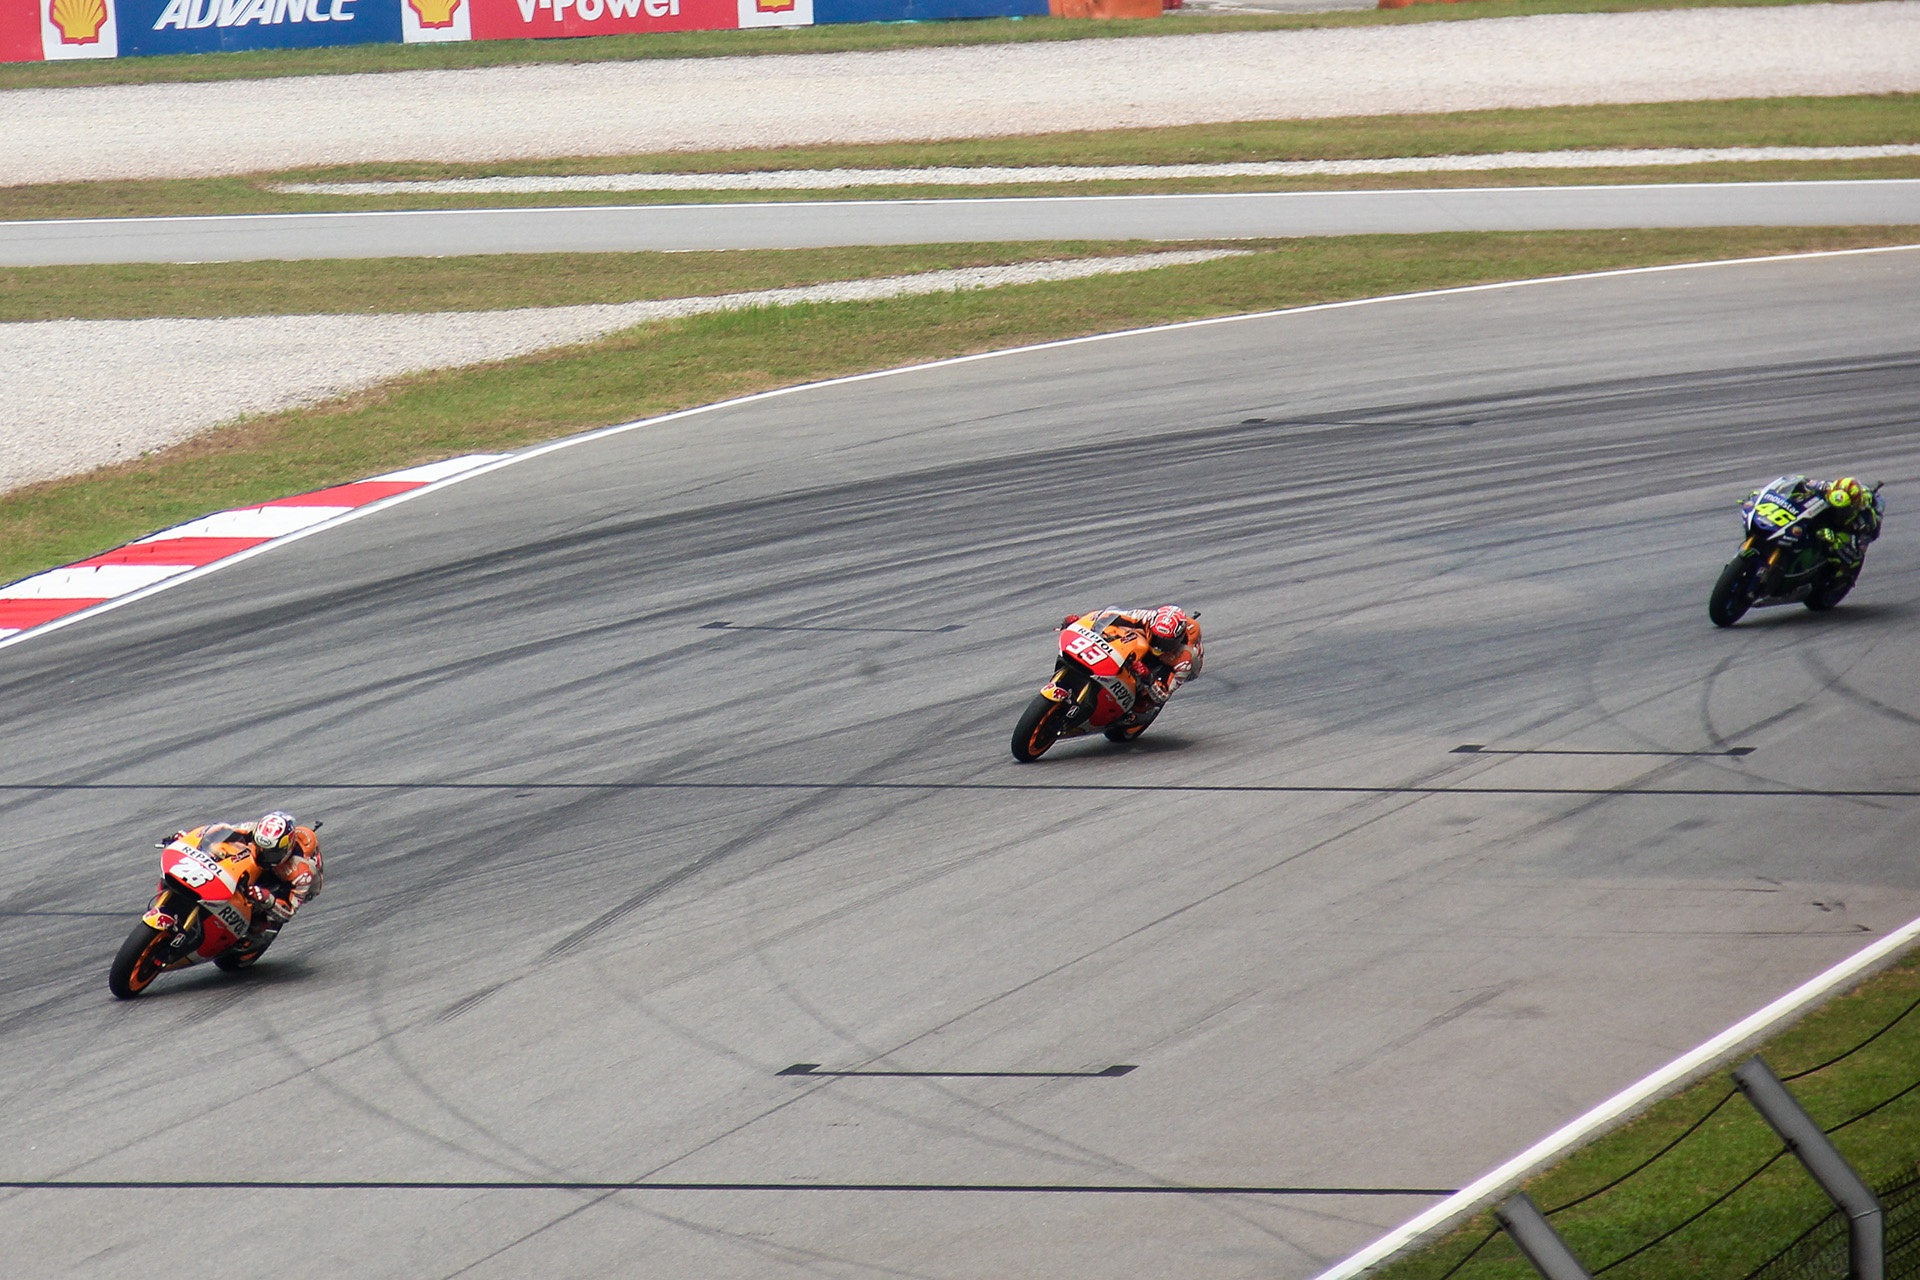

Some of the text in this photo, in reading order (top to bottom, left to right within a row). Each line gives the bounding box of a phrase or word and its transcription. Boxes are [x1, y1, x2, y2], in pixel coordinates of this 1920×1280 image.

[152, 0, 358, 30] ADVANCE
[1754, 502, 1797, 527] 46
[1763, 493, 1800, 515] movistar
[1065, 636, 1108, 666] 93
[1078, 627, 1114, 654] REPSOL
[168, 856, 215, 888] 26
[182, 846, 224, 876] REPSOL
